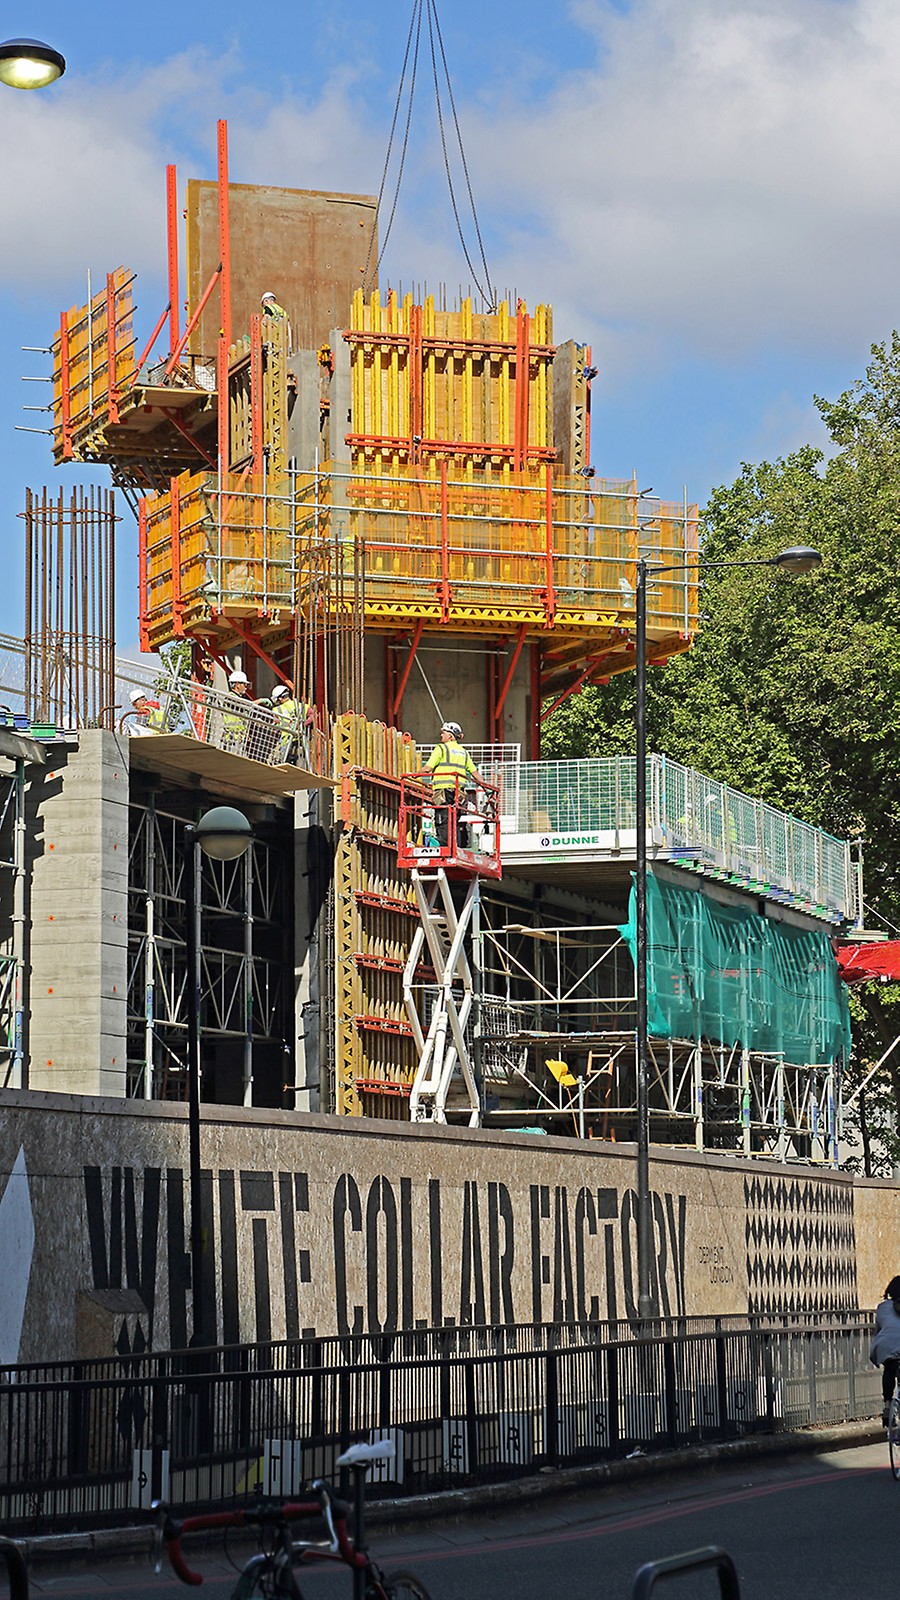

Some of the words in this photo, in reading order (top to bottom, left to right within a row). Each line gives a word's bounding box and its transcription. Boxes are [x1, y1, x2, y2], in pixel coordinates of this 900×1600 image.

[552, 836, 599, 845] DUNNE
[83, 1165, 316, 1372] WHITE
[332, 1172, 516, 1362] COLLAR
[530, 1184, 687, 1347] FACTORY
